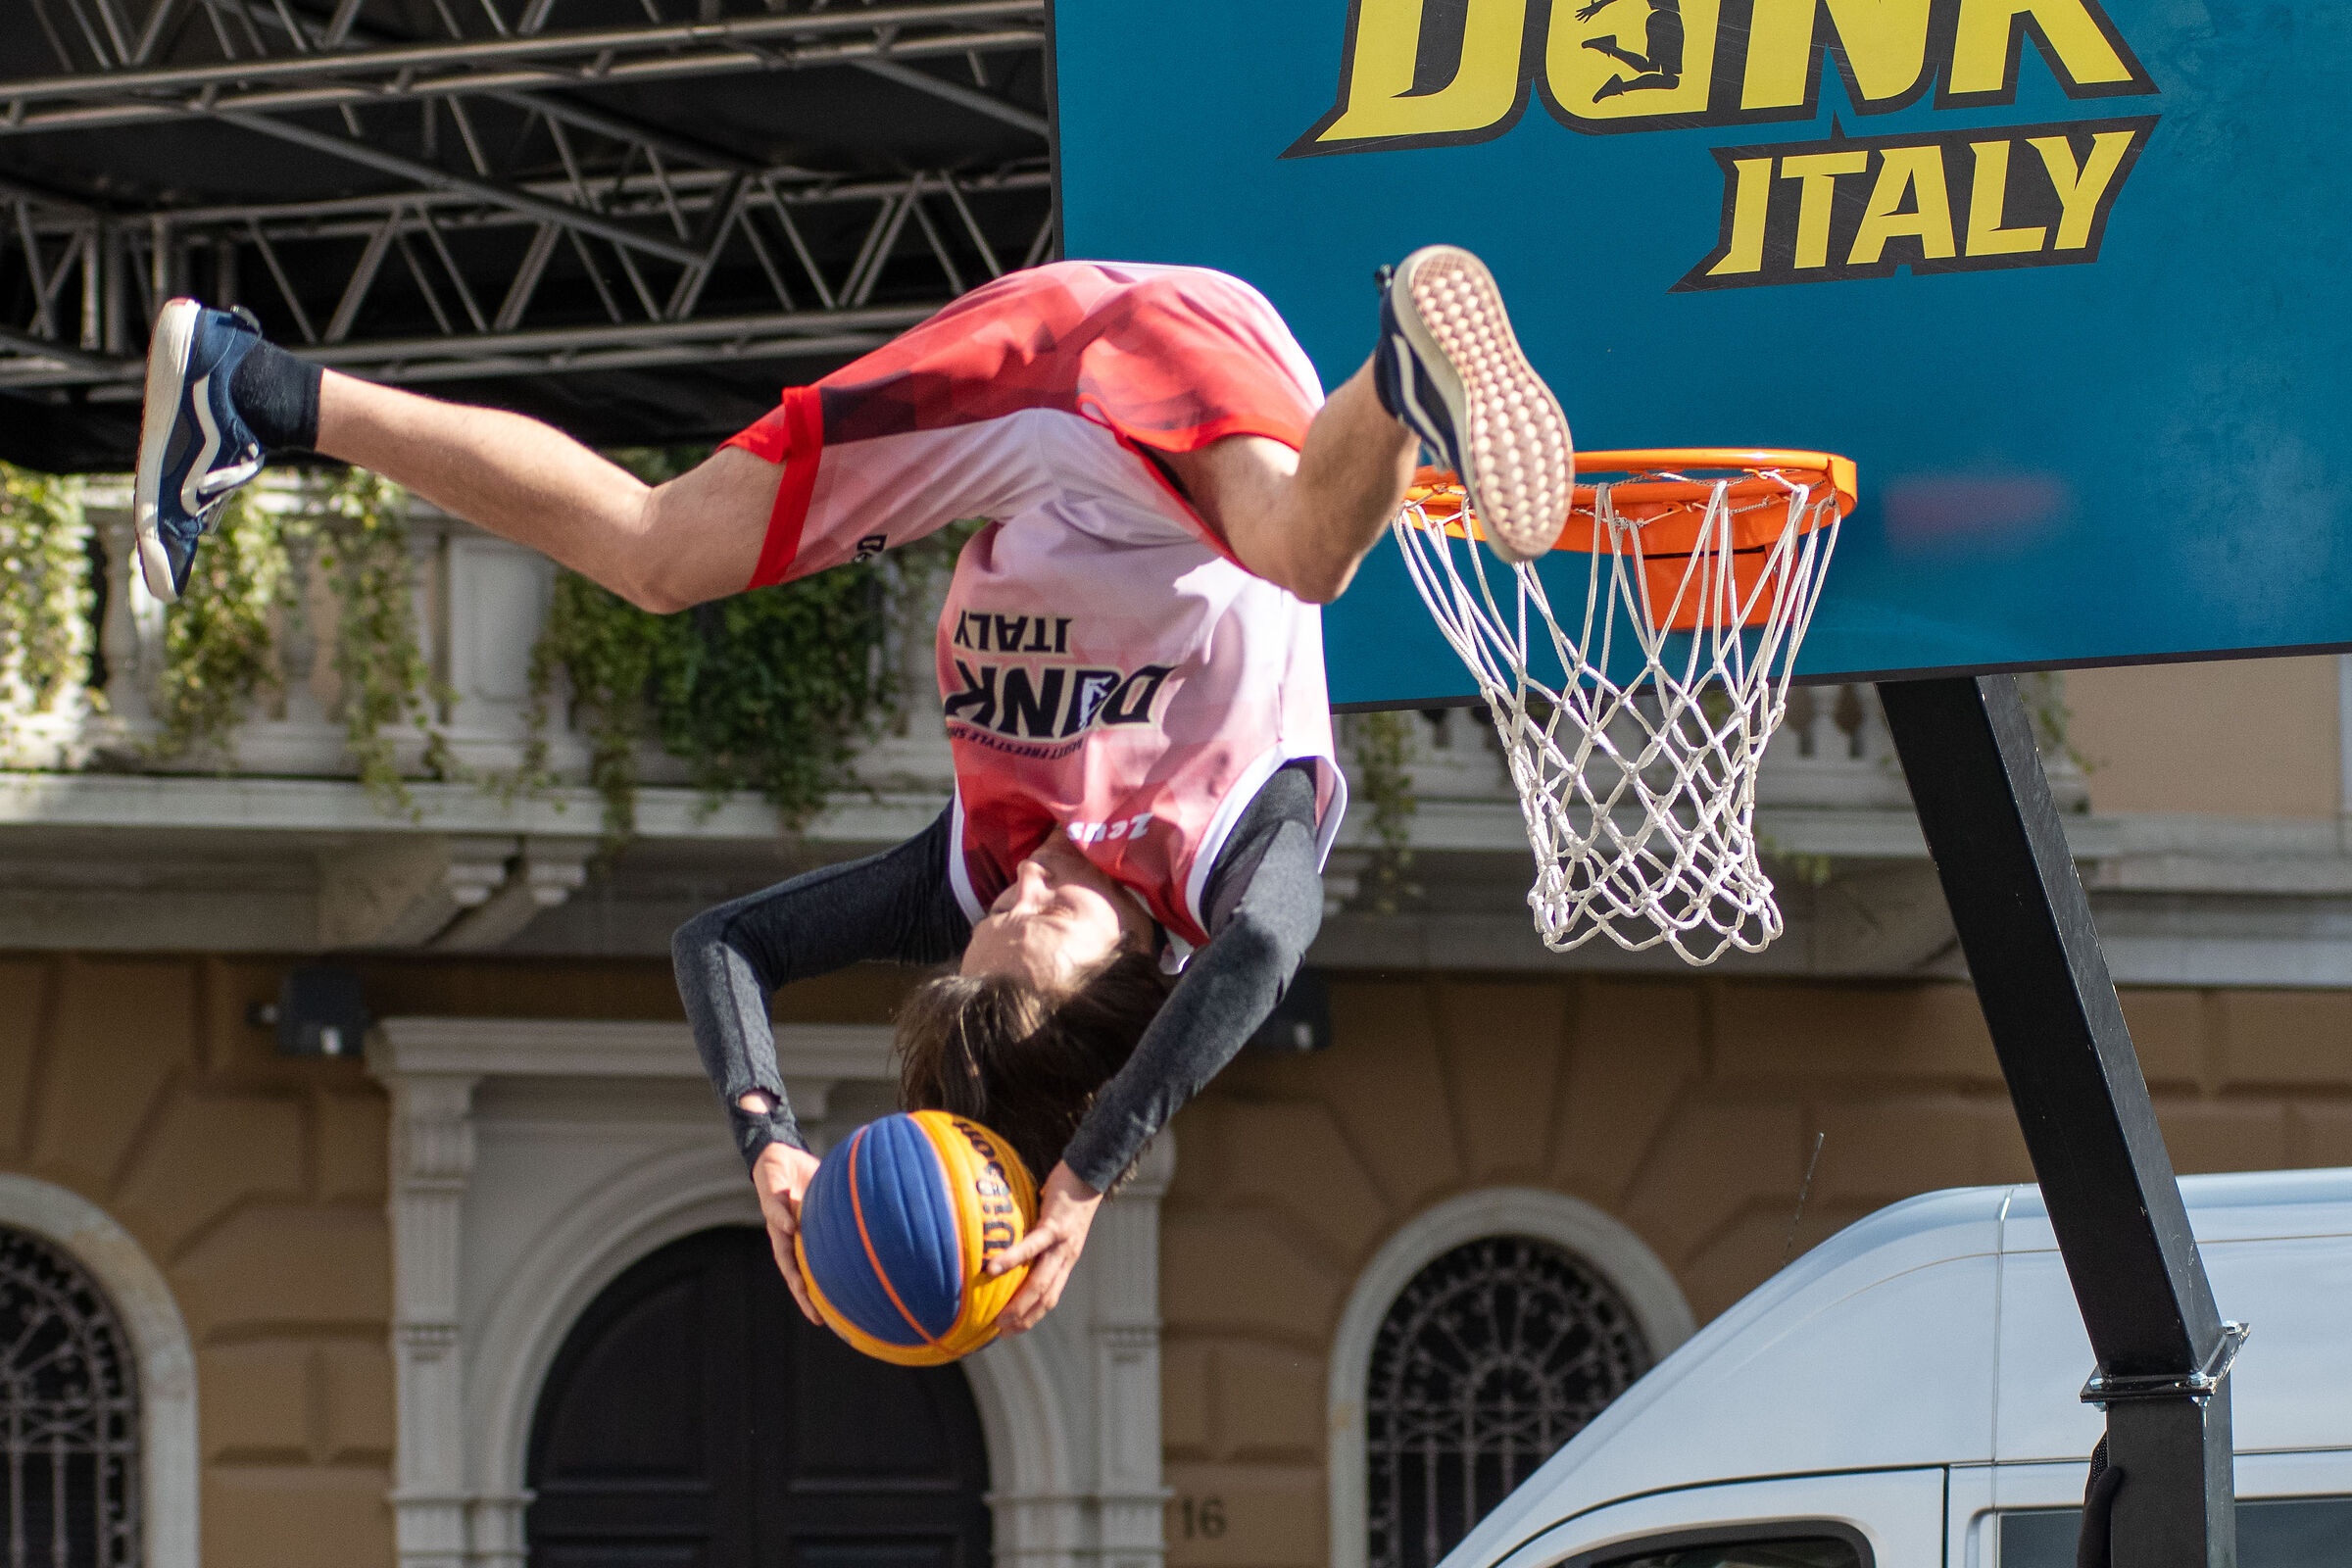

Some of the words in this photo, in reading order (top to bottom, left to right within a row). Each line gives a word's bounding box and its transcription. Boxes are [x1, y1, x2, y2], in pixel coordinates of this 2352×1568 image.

[1705, 130, 2135, 276] ITALY
[954, 610, 1073, 654] ITALY
[945, 660, 1178, 738] DUNK
[1182, 1495, 1227, 1539] 16
